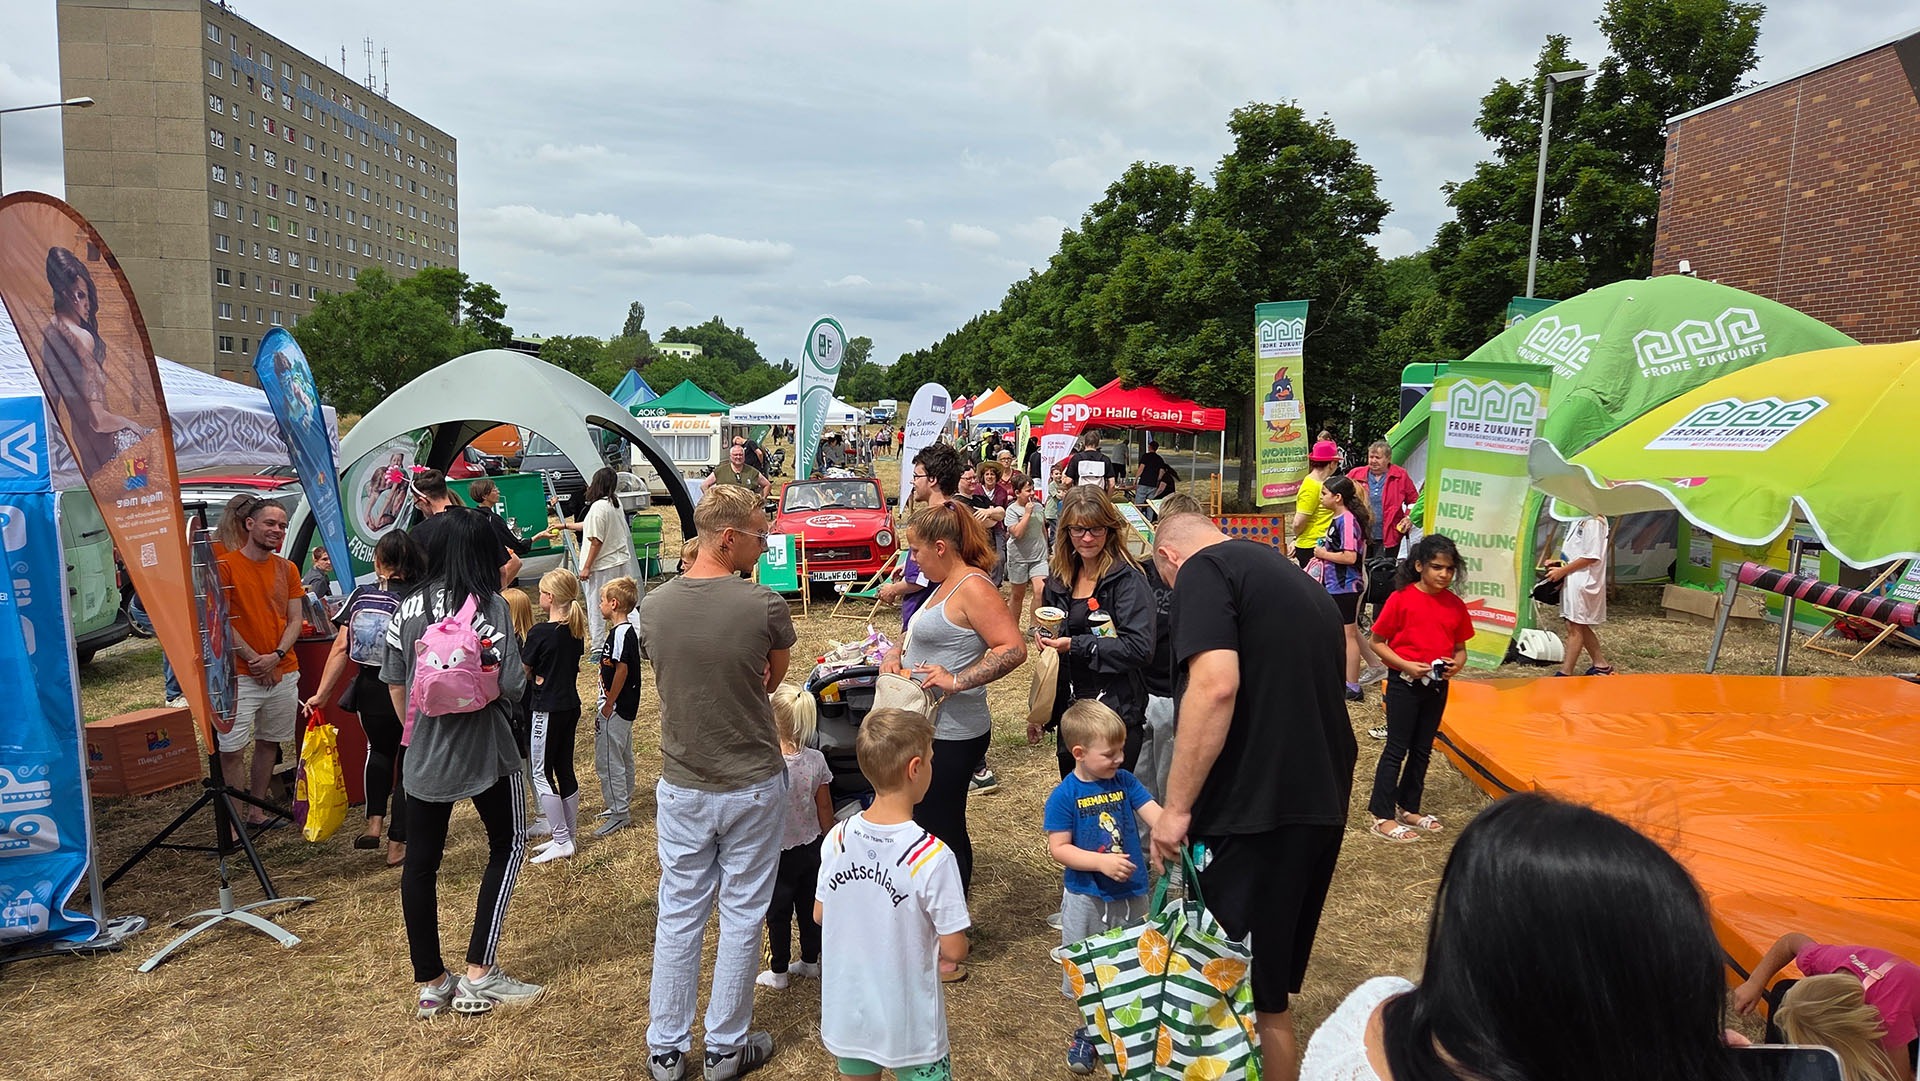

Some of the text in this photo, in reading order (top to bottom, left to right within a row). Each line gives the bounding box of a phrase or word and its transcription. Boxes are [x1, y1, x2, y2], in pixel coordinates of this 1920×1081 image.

[232, 51, 276, 89] HOTEL
[1516, 345, 1541, 363] FROHE
[1640, 341, 1768, 378] FROHE ZUKUNFT
[636, 408, 657, 417] AOK
[1050, 403, 1090, 422] SPD
[1106, 407, 1138, 419] Halle
[1141, 407, 1183, 424] (Saale)
[642, 419, 711, 429] HWG MOBIL
[802, 391, 831, 466] WILLKOMMEN
[1448, 421, 1533, 438] FROHE ZUKUNFT
[1665, 428, 1790, 437] FROHE ZUKUNFT
[1261, 446, 1308, 458] WOHNEN
[1441, 477, 1482, 497] DEINE
[1437, 501, 1475, 521] NEUE
[348, 535, 377, 562] FREIH
[813, 570, 857, 580] HAL WF 66H
[137, 746, 188, 767] Maya mare
[1077, 790, 1125, 809] FIREMAN SAM
